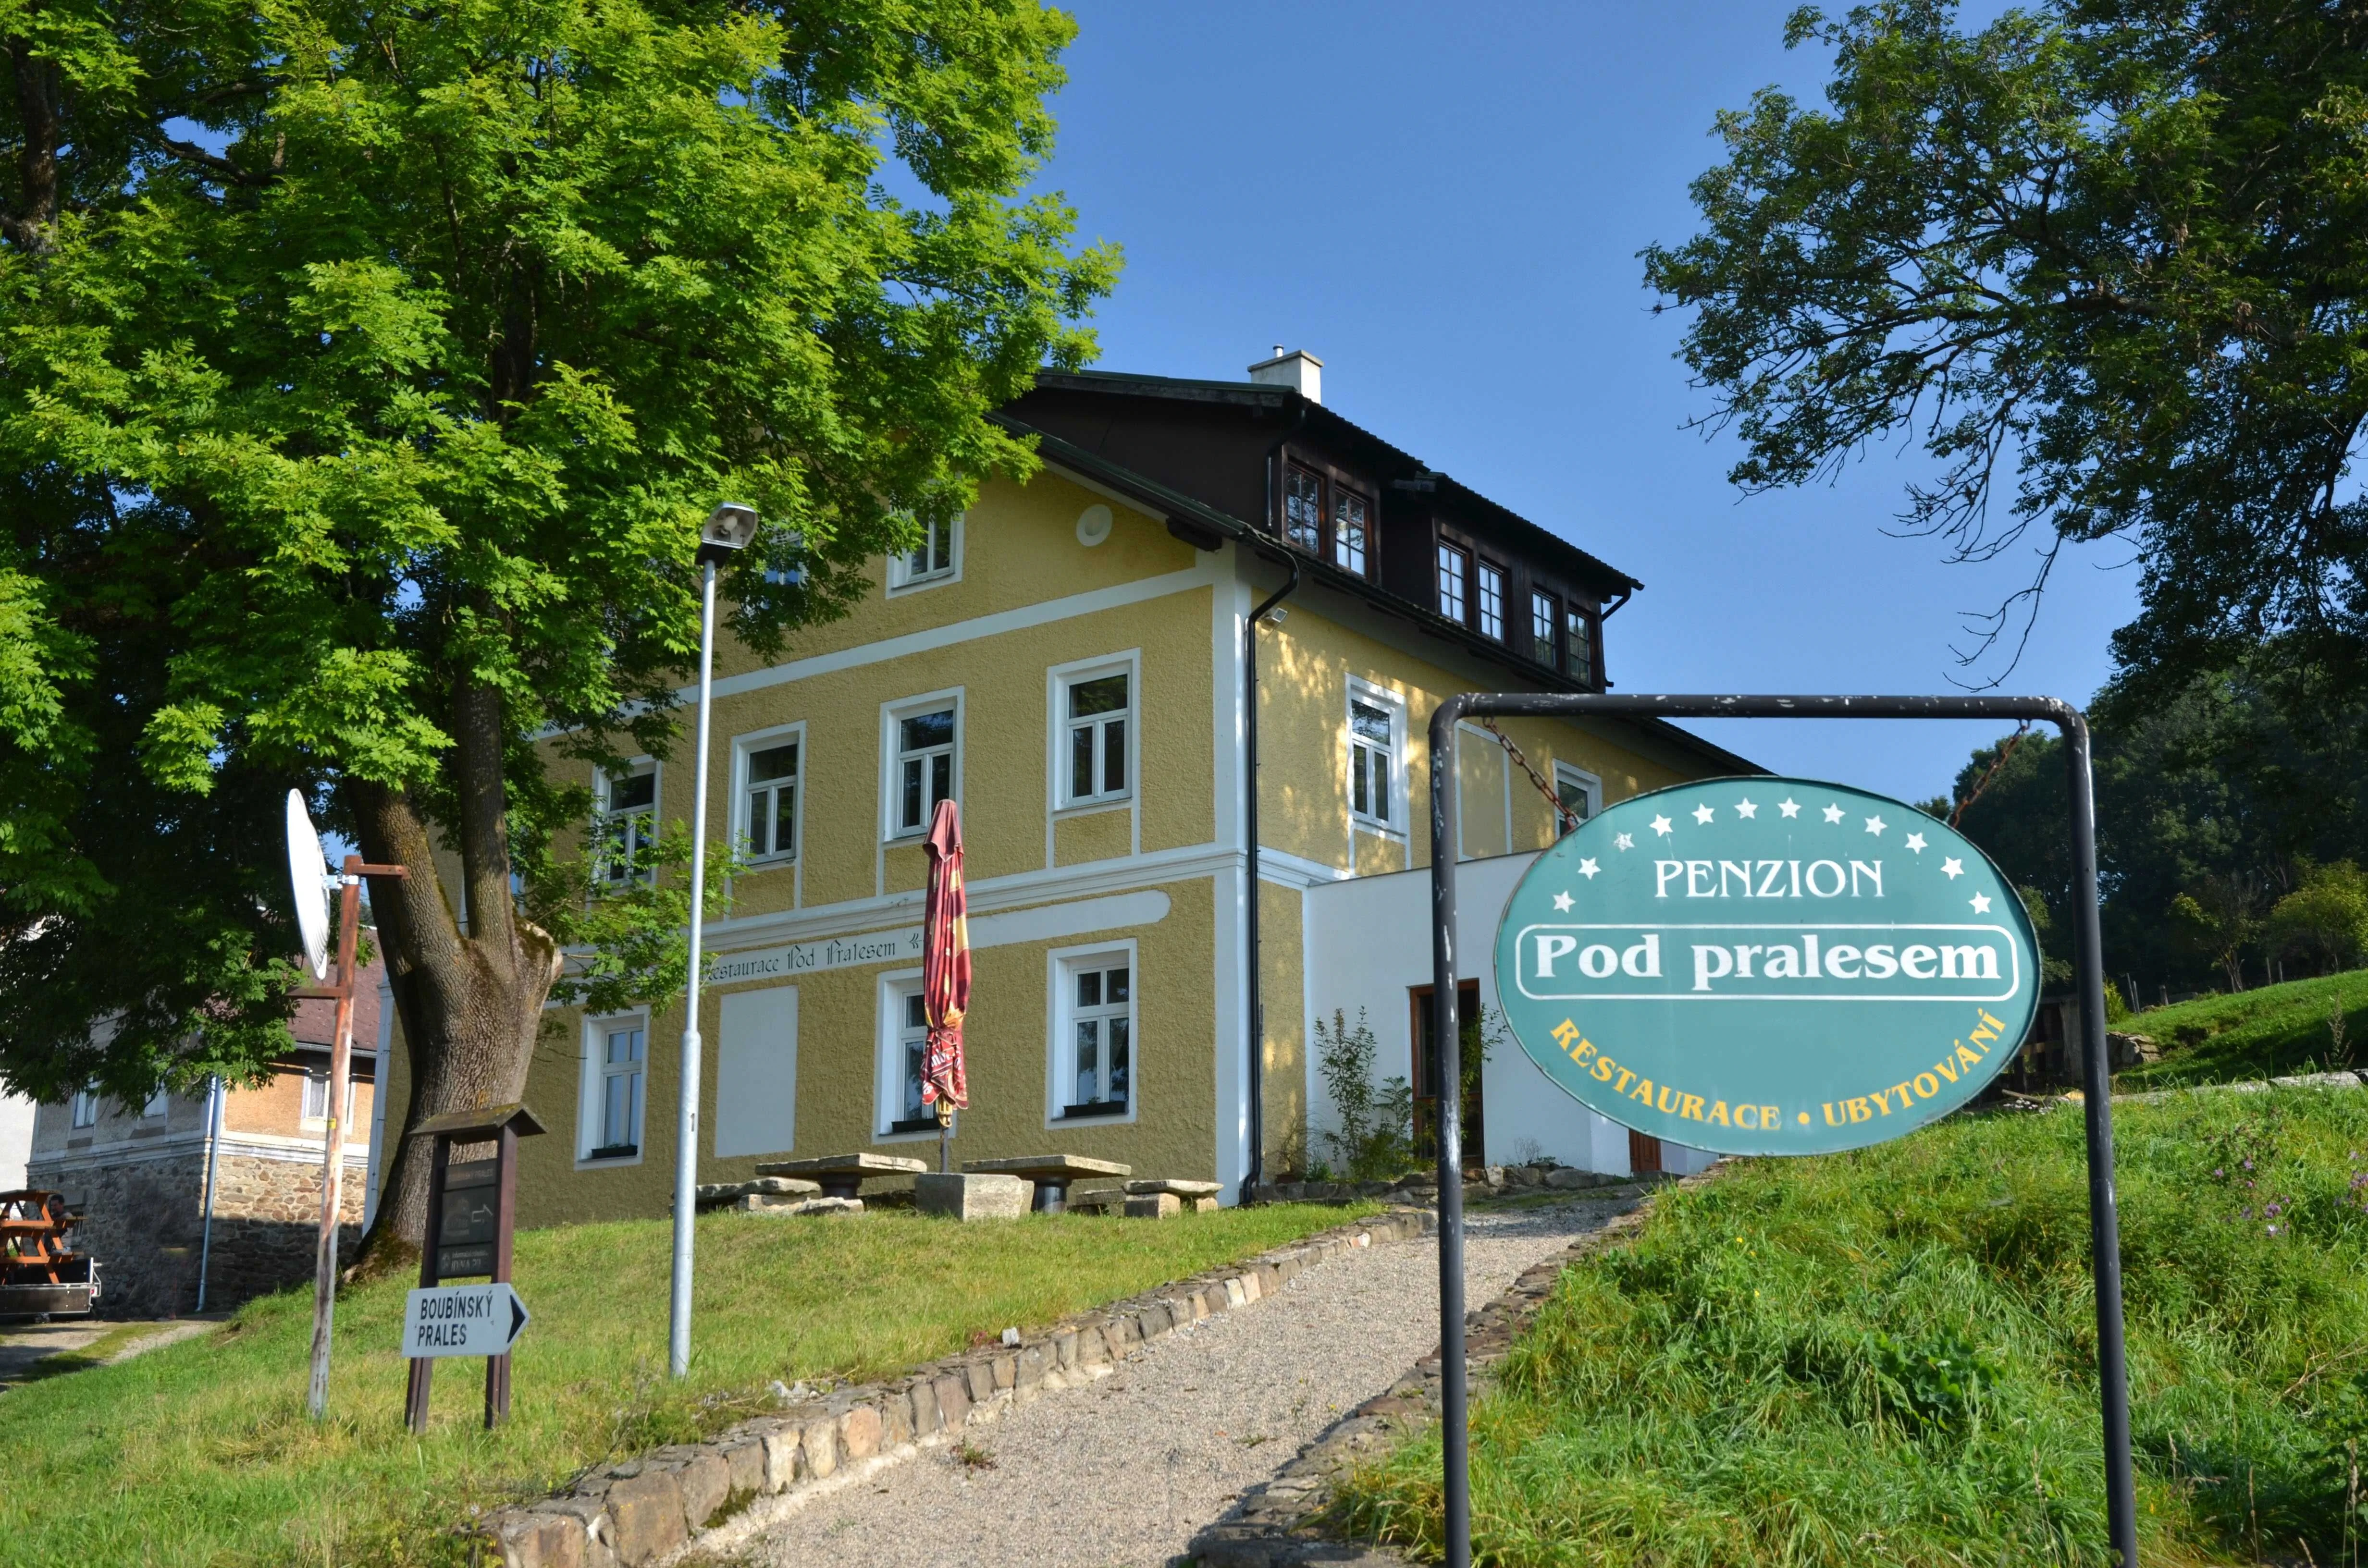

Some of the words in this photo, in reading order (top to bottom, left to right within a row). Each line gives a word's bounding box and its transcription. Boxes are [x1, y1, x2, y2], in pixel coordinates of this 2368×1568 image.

[1653, 859, 1884, 898] PENZION
[787, 944, 814, 970] Pod
[826, 939, 896, 965] Pralesem
[1534, 933, 1662, 979] Pod
[1690, 933, 2002, 992] pralesem
[1550, 1017, 1781, 1131] RESTAURACE
[1822, 1007, 2007, 1127] UBYTOVÁNÍ
[420, 1290, 493, 1320] BOUBÍNSKÝ
[417, 1323, 467, 1347] PRALES
